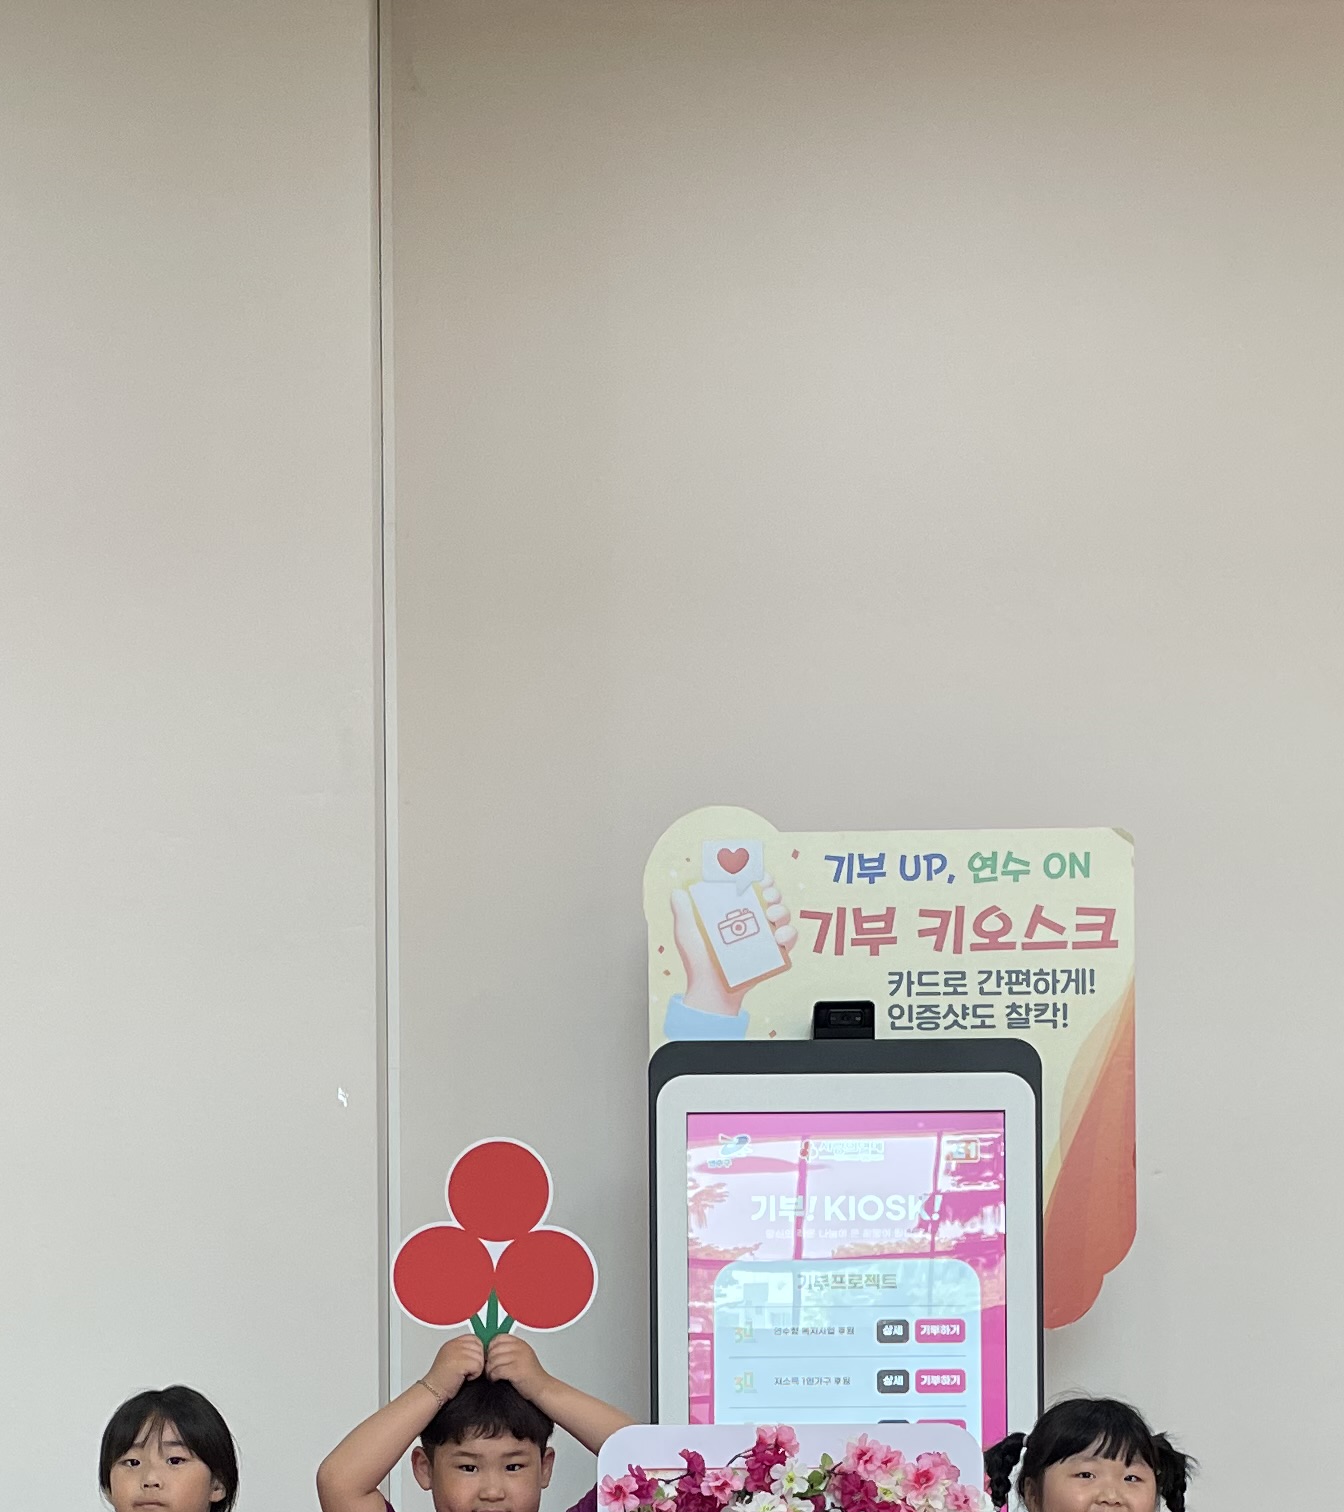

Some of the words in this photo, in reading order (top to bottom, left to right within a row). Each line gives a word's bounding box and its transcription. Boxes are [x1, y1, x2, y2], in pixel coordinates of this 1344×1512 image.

[824, 852, 886, 884] 기부
[899, 852, 956, 884] UP,
[967, 850, 1031, 883] 연수
[1043, 851, 1090, 880] ON
[799, 905, 897, 957] 기부
[917, 903, 1119, 955] 키오스크
[887, 970, 968, 997] 카드로
[977, 968, 1096, 996] 간편하게!
[887, 1003, 996, 1031] 인증샷도
[1005, 1002, 1069, 1029] 찰칵!
[751, 1194, 816, 1222] 기부!
[824, 1194, 943, 1222] KIOSK!
